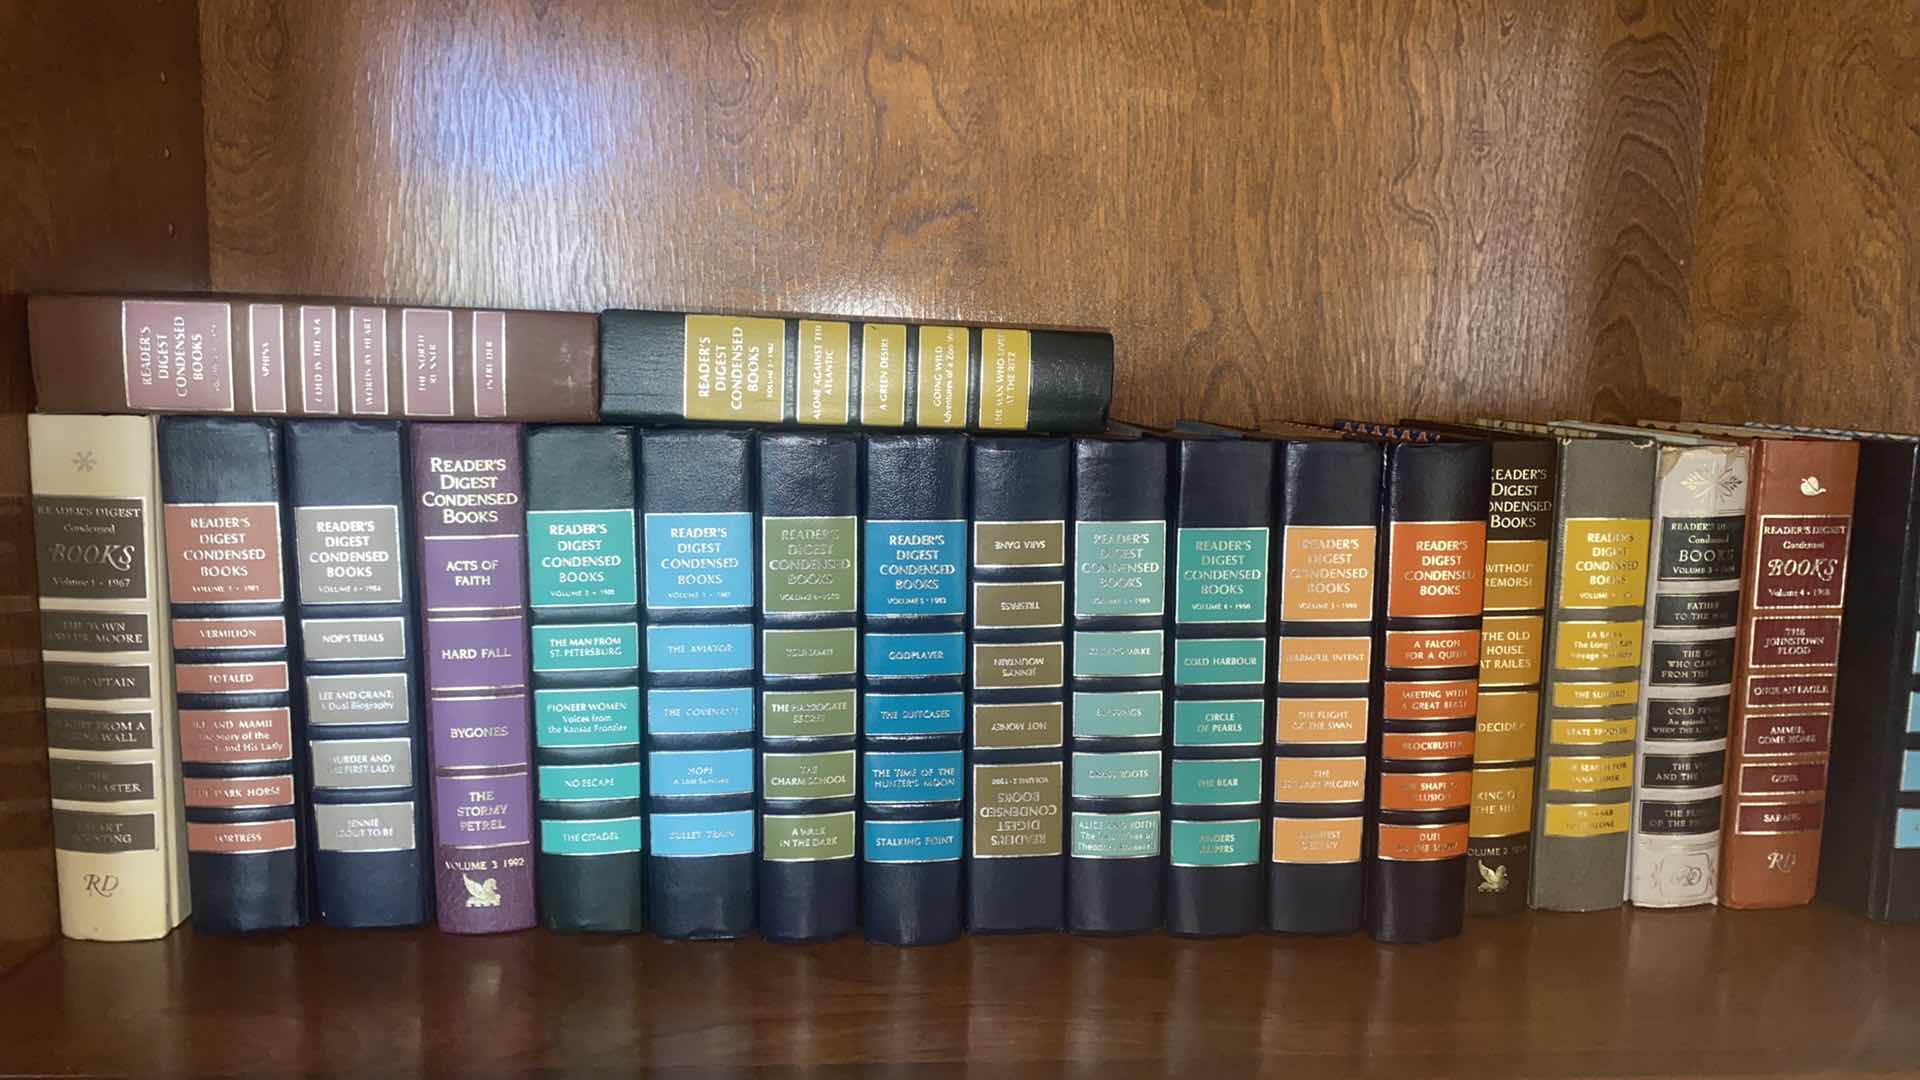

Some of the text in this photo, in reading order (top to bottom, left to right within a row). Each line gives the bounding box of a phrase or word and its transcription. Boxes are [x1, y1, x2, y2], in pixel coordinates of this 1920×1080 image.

[157, 334, 169, 379] DIGEST
[174, 316, 188, 397] CONDENSED
[192, 333, 204, 380] BOOKS
[698, 336, 711, 397] READER'S
[715, 344, 727, 391] DIGEST
[731, 327, 743, 410] CONDENSED
[747, 345, 760, 392] BOOKS
[933, 346, 943, 408] GOING WILD
[1007, 374, 1016, 391] THE
[880, 403, 888, 412] A
[430, 457, 506, 473] READER'S
[440, 474, 498, 489] DIGEST
[1491, 483, 1538, 496] DIGEST
[422, 491, 518, 507] CONDENSED
[95, 507, 142, 518] DIGEST
[443, 509, 499, 524] BOOKS
[191, 517, 251, 529] READER'S
[316, 520, 376, 533] READER'S
[1490, 514, 1536, 529] BOOKS
[549, 524, 608, 536] READER'S
[671, 527, 728, 538] READER'S
[1764, 525, 1811, 535] READER'S
[200, 533, 246, 545] DIGEST
[325, 536, 370, 548] DIGEST
[889, 535, 945, 546] READER'S
[1302, 538, 1360, 549] READER'S
[558, 540, 603, 551] DIGEST
[677, 543, 722, 554] DIGEST
[994, 540, 1046, 550] SARA DANE
[1196, 540, 1252, 551] READER'S
[1416, 540, 1468, 551] READER'S
[48, 543, 135, 571] BOOKS
[183, 548, 266, 561] CONDENSED
[310, 551, 389, 563] CONDENSED
[896, 550, 939, 561] DIGEST
[1201, 555, 1245, 565] DIGEST
[446, 560, 500, 572] ACTS OF
[542, 555, 622, 568] CONDENSED
[660, 557, 739, 570] CONDENSED
[769, 559, 851, 571] CONDENSED
[1422, 555, 1462, 566] DIGEST
[200, 565, 249, 577] BOOKS
[327, 566, 373, 578] BOOKS
[880, 564, 955, 575] CONDENSED
[1184, 569, 1262, 580] CONDENSED
[1768, 558, 1838, 581] BOOKS
[559, 571, 606, 583] BOOKS
[677, 574, 723, 585] BOOKS
[1404, 570, 1475, 581] CONDENSED
[455, 576, 491, 587] FAITH
[896, 579, 939, 590] BOOKS
[1201, 584, 1244, 595] BOOKS
[1307, 582, 1351, 593] BOOKS
[1420, 585, 1461, 596] BOOKS
[1580, 592, 1608, 600] VOLUME
[1674, 612, 1688, 621] TO
[1482, 631, 1531, 641] THE OLD
[1785, 628, 1806, 636] THE
[353, 633, 384, 643] TRIALS
[550, 636, 622, 647] THE MAN FROM
[1414, 639, 1461, 648] A FALCON
[1764, 637, 1825, 648] JOHNSTOWN
[441, 648, 512, 660] HARD FALL
[564, 647, 623, 657] PETERSBURG
[668, 643, 733, 654] THE AVIATOR
[1487, 645, 1524, 655] HOUSE
[1682, 650, 1700, 658] THE
[1778, 646, 1811, 655] FLOOD
[889, 650, 944, 660] GODPLAYER
[1213, 656, 1257, 665] HARBOUR
[1332, 653, 1365, 662] INTENT
[1427, 651, 1435, 660] A
[1494, 658, 1531, 668] RAILES
[208, 674, 254, 684] TOTALED
[1661, 670, 1689, 679] FROM
[1783, 685, 1795, 694] AN
[336, 691, 357, 700] AND
[547, 701, 627, 713] PIONEER WOMEN
[772, 703, 790, 712] THE
[1412, 702, 1441, 710] GREAT
[1667, 707, 1695, 715] GOLD
[664, 707, 681, 717] THE
[881, 711, 898, 720] THE
[1205, 713, 1235, 722] CIRCLE
[1317, 711, 1349, 720] FLIGHT
[562, 713, 612, 723] Voices from
[135, 721, 146, 731] A
[548, 725, 561, 734] the
[1027, 721, 1047, 730] NOT
[1212, 723, 1242, 732] PEARLS
[1327, 721, 1353, 730] SWAN
[450, 726, 510, 739] BYGONES
[1758, 735, 1786, 745] COME
[370, 754, 392, 764] AND
[371, 764, 396, 774] LADY
[1672, 762, 1691, 771] THE
[872, 767, 955, 778] THE TIME OF THE
[1656, 773, 1677, 781] AND
[565, 778, 615, 788] NO ESCAPE
[1216, 778, 1238, 787] BEAR
[468, 791, 495, 802] THE
[998, 791, 1040, 803] BOOKS
[456, 804, 509, 818] STORMY
[980, 804, 1057, 818] CONDENSED
[1664, 809, 1683, 817] THE
[460, 818, 506, 832] PETREL
[996, 820, 1040, 832] DIGEST
[1667, 819, 1686, 827] THE
[368, 828, 381, 837] TO
[564, 832, 619, 842] THE CITADEL
[791, 828, 799, 836] A
[779, 836, 838, 847] IN THE DARK
[876, 836, 954, 847] STALKING POINT
[445, 857, 526, 872] VOLUME 3 1992
